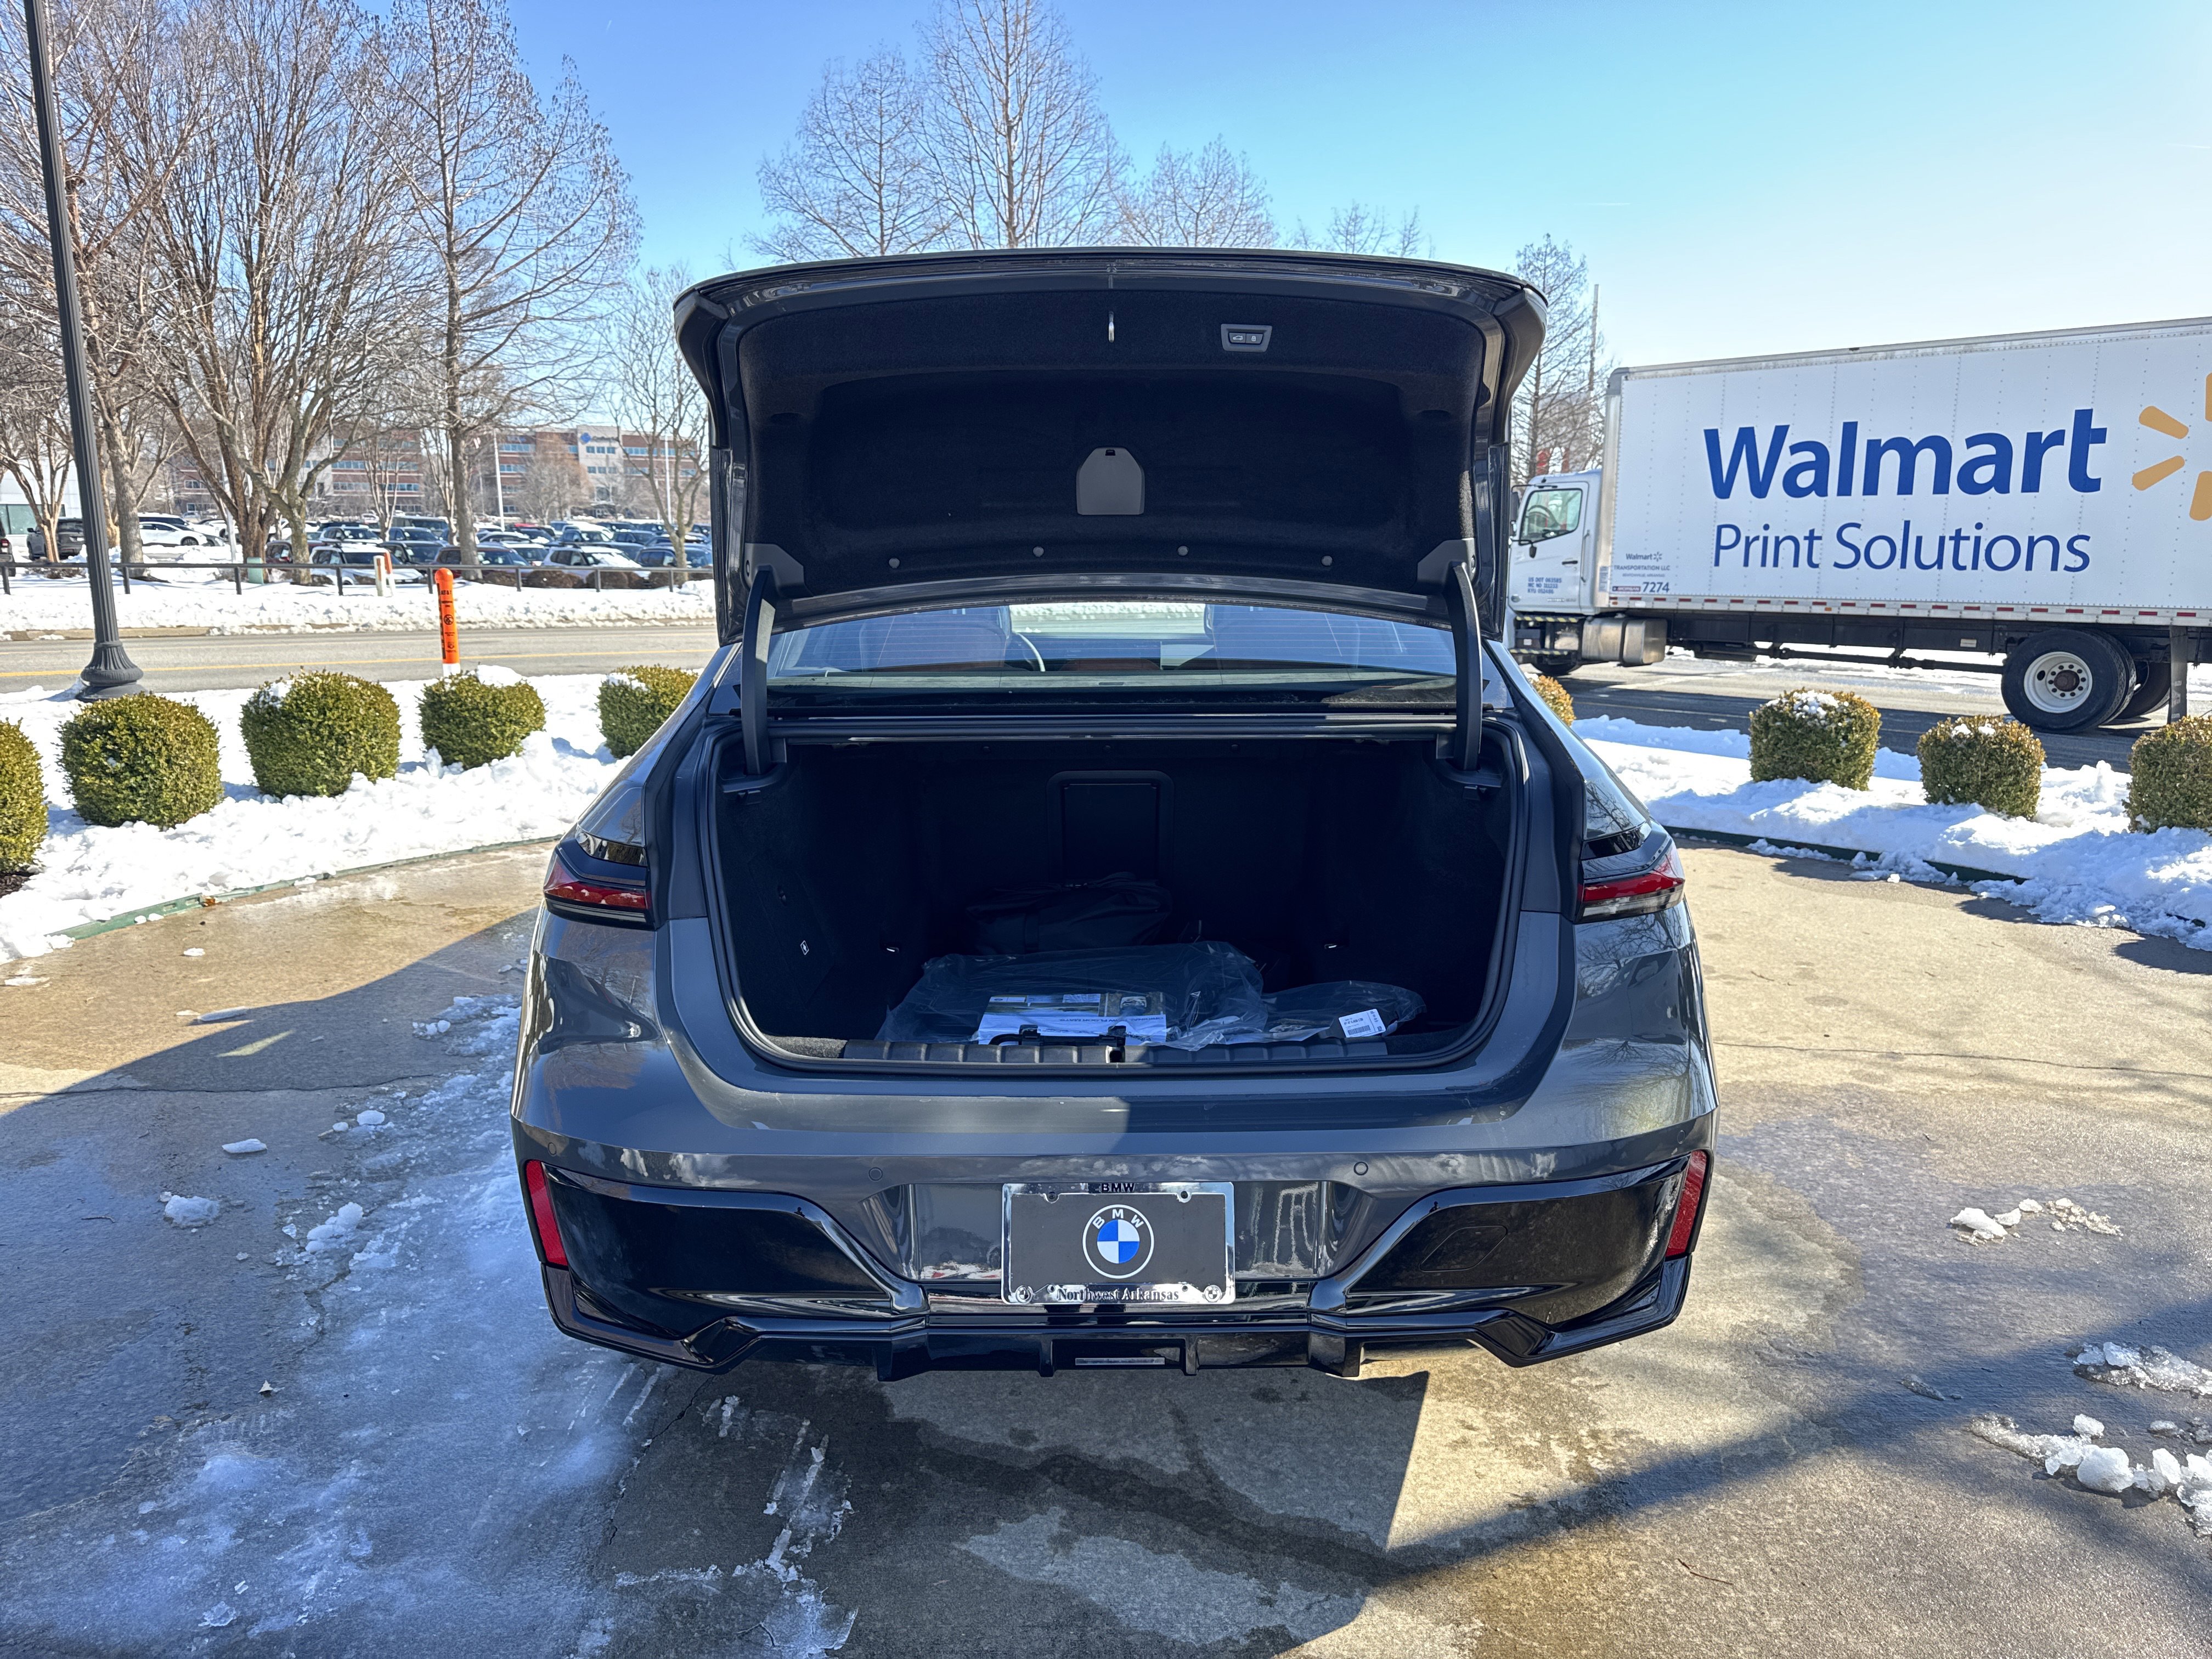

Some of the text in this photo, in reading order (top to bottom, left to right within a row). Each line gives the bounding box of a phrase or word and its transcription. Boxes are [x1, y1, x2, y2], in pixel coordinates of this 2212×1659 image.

[1703, 408, 2108, 500] Walmart
[1713, 520, 2091, 572] Print Solutions
[1643, 582, 1669, 592] 7274
[1101, 1182, 1135, 1192] BMW
[1092, 1209, 1144, 1229] BMW
[1058, 1287, 1179, 1300] Northwest Arkansas
